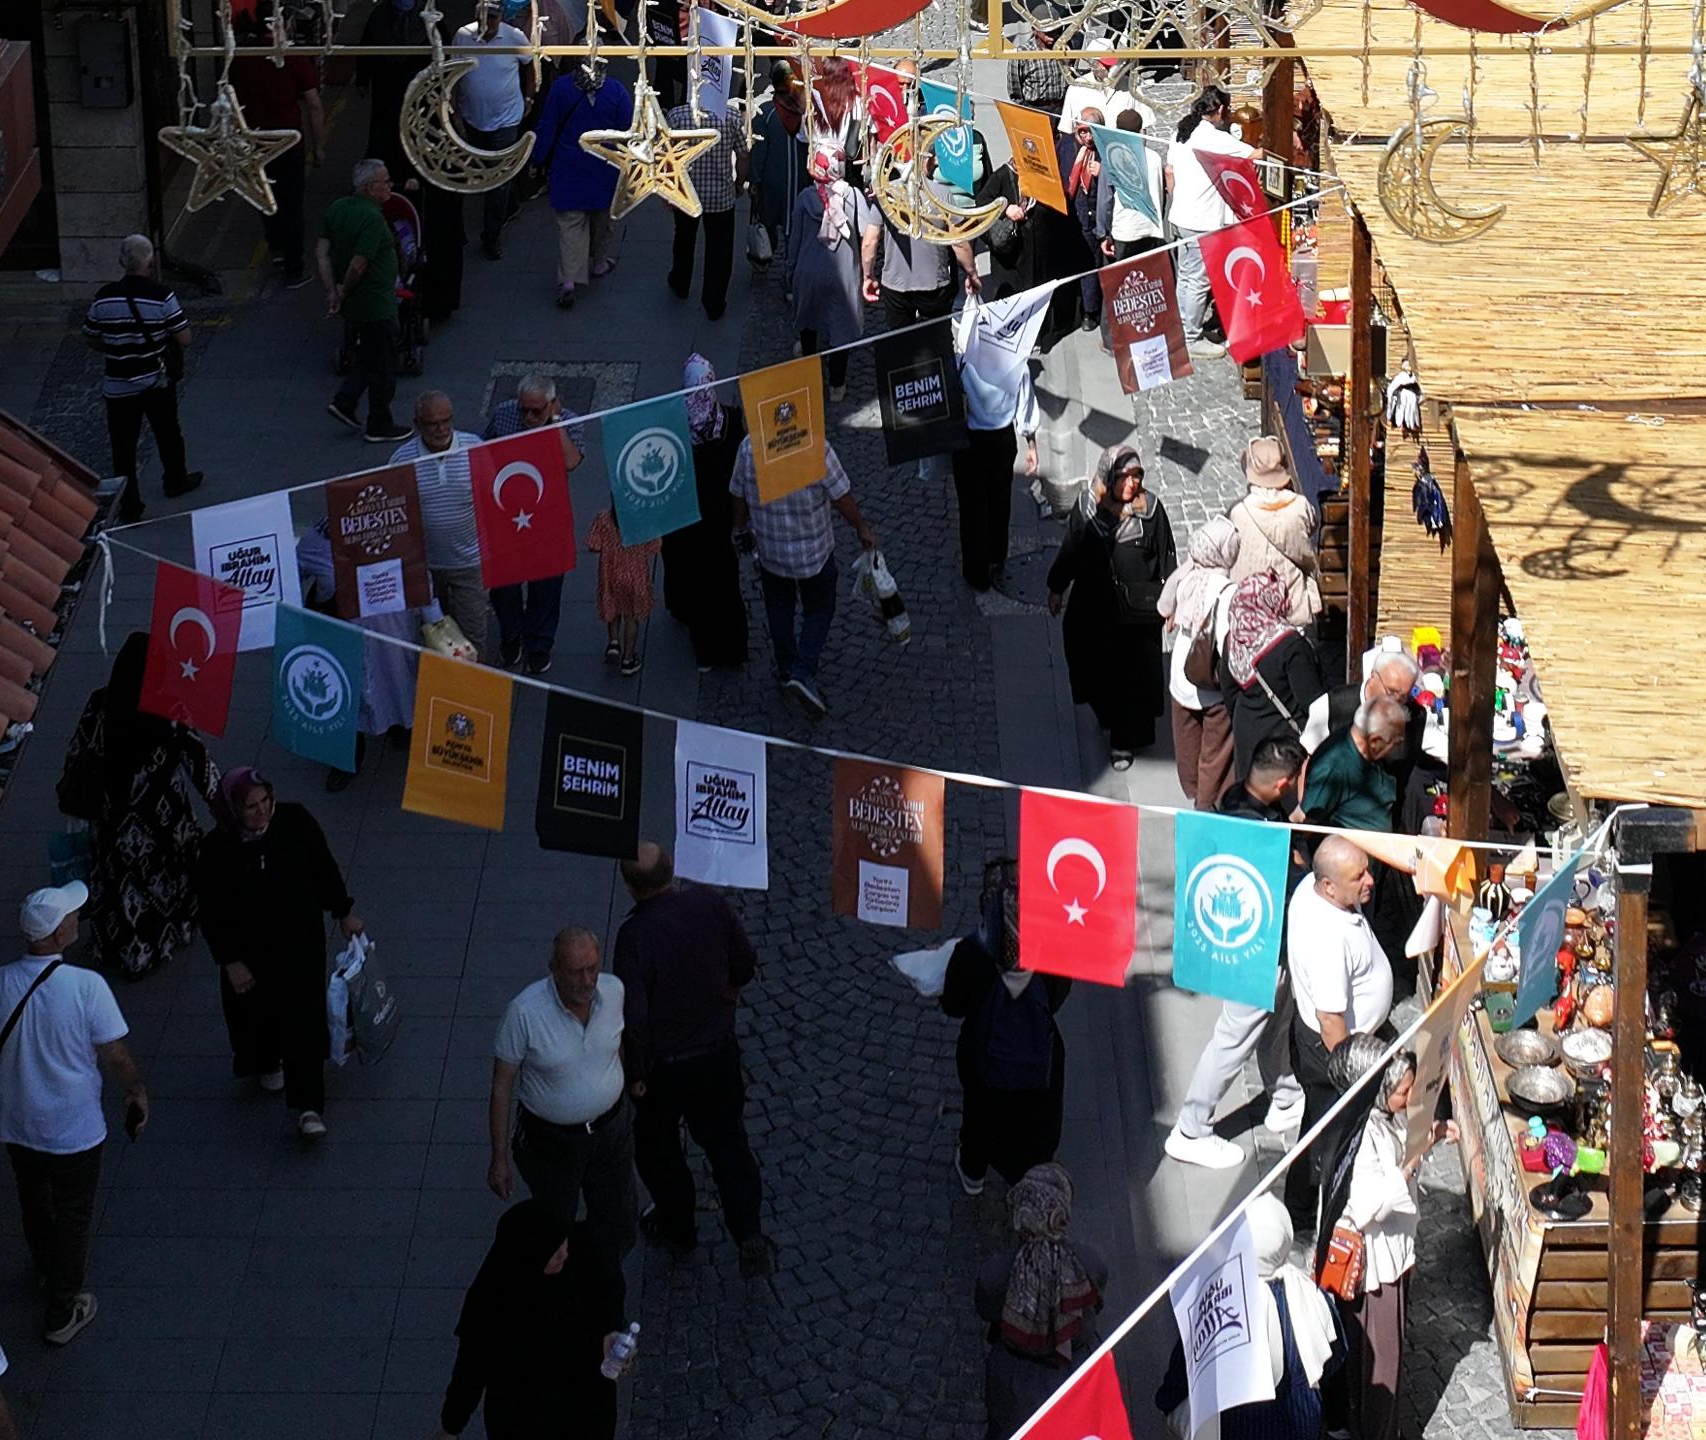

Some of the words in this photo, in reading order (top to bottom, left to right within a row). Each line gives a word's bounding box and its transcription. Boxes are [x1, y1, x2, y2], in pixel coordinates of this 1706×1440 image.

[1113, 287, 1166, 317] BEDESTEN
[895, 374, 941, 398] BENİM
[897, 391, 943, 415] ŞEHRİM
[340, 505, 409, 536] BEDESTEN
[228, 547, 261, 561] UĞUR
[223, 567, 275, 594] Altay
[563, 754, 620, 782] BENİM
[704, 774, 737, 789] UĞUR
[562, 776, 619, 799] ŞEHRİM
[690, 796, 750, 830] Altay
[849, 798, 925, 832] BEDESTEN
[1187, 920, 1207, 952] 2025
